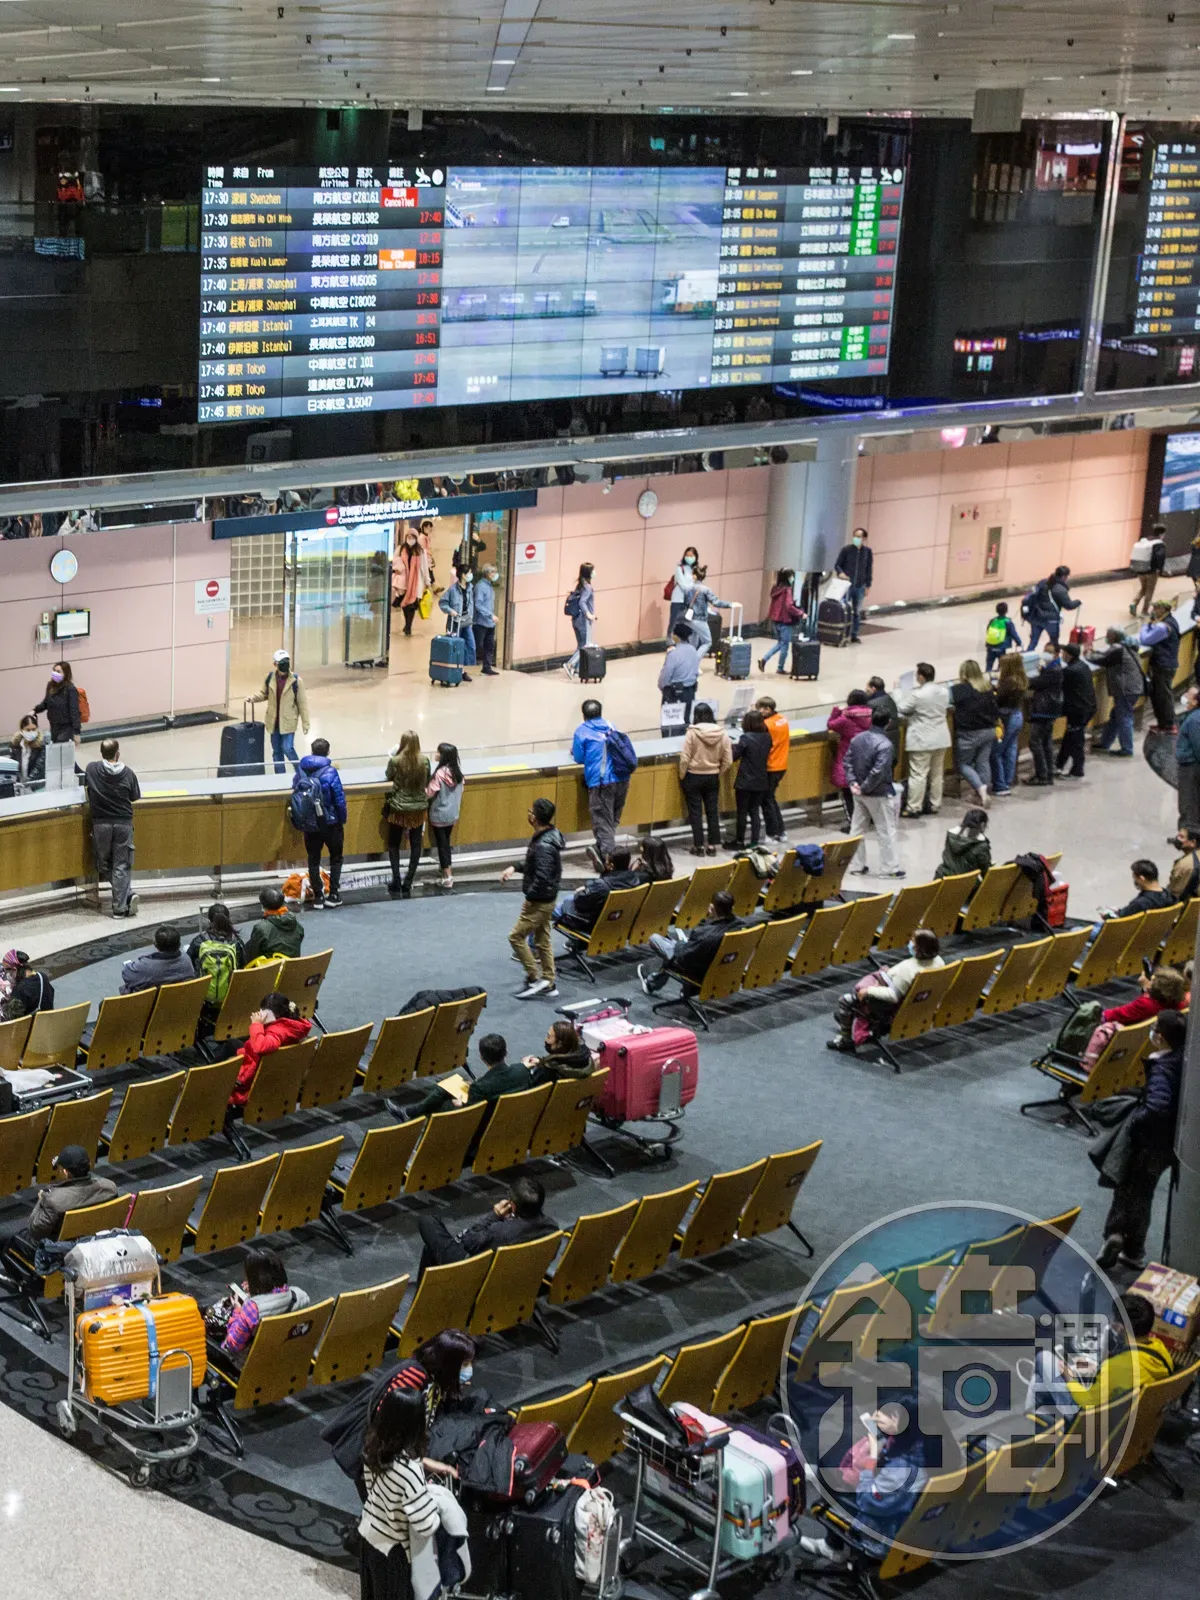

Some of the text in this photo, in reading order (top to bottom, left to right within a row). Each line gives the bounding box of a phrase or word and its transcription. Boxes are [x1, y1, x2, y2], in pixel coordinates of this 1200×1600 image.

[258, 167, 274, 178] From
[204, 192, 228, 204] 17:30
[250, 193, 281, 204] Shenzhen
[204, 214, 228, 226] 17:30
[204, 236, 227, 248] 17:30
[249, 236, 272, 247] Guilin
[203, 257, 227, 270] 17:35
[203, 299, 296, 313] 17:40 Shanghai
[202, 320, 292, 334] 17:40 Istanbul
[201, 364, 265, 377] 17:45 Tokyo
